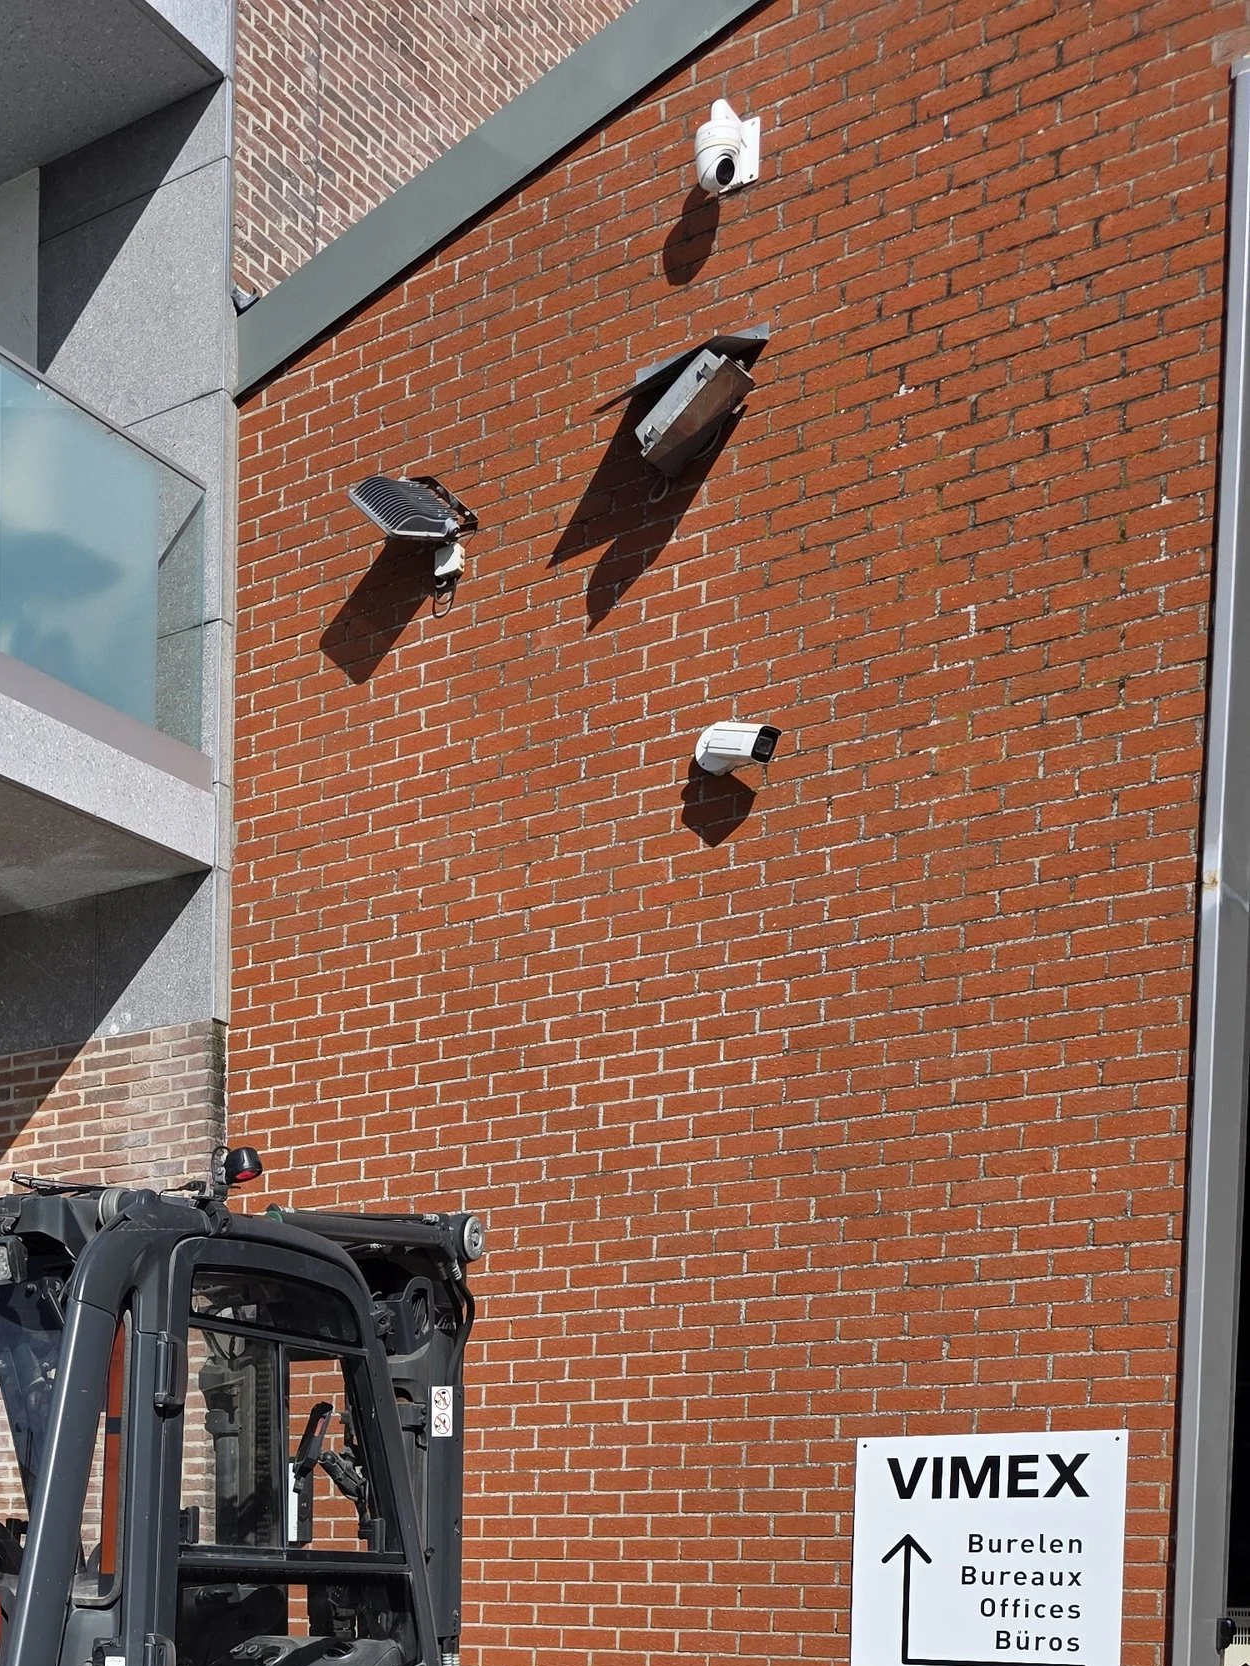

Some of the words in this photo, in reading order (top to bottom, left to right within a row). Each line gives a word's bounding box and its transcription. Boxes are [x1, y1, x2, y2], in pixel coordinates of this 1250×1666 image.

[886, 1453, 1090, 1500] VIMEX
[967, 1533, 1083, 1554] Burelen
[961, 1565, 1082, 1587] Bureaux
[979, 1597, 1081, 1619] Offices
[995, 1629, 1080, 1652] Büros
